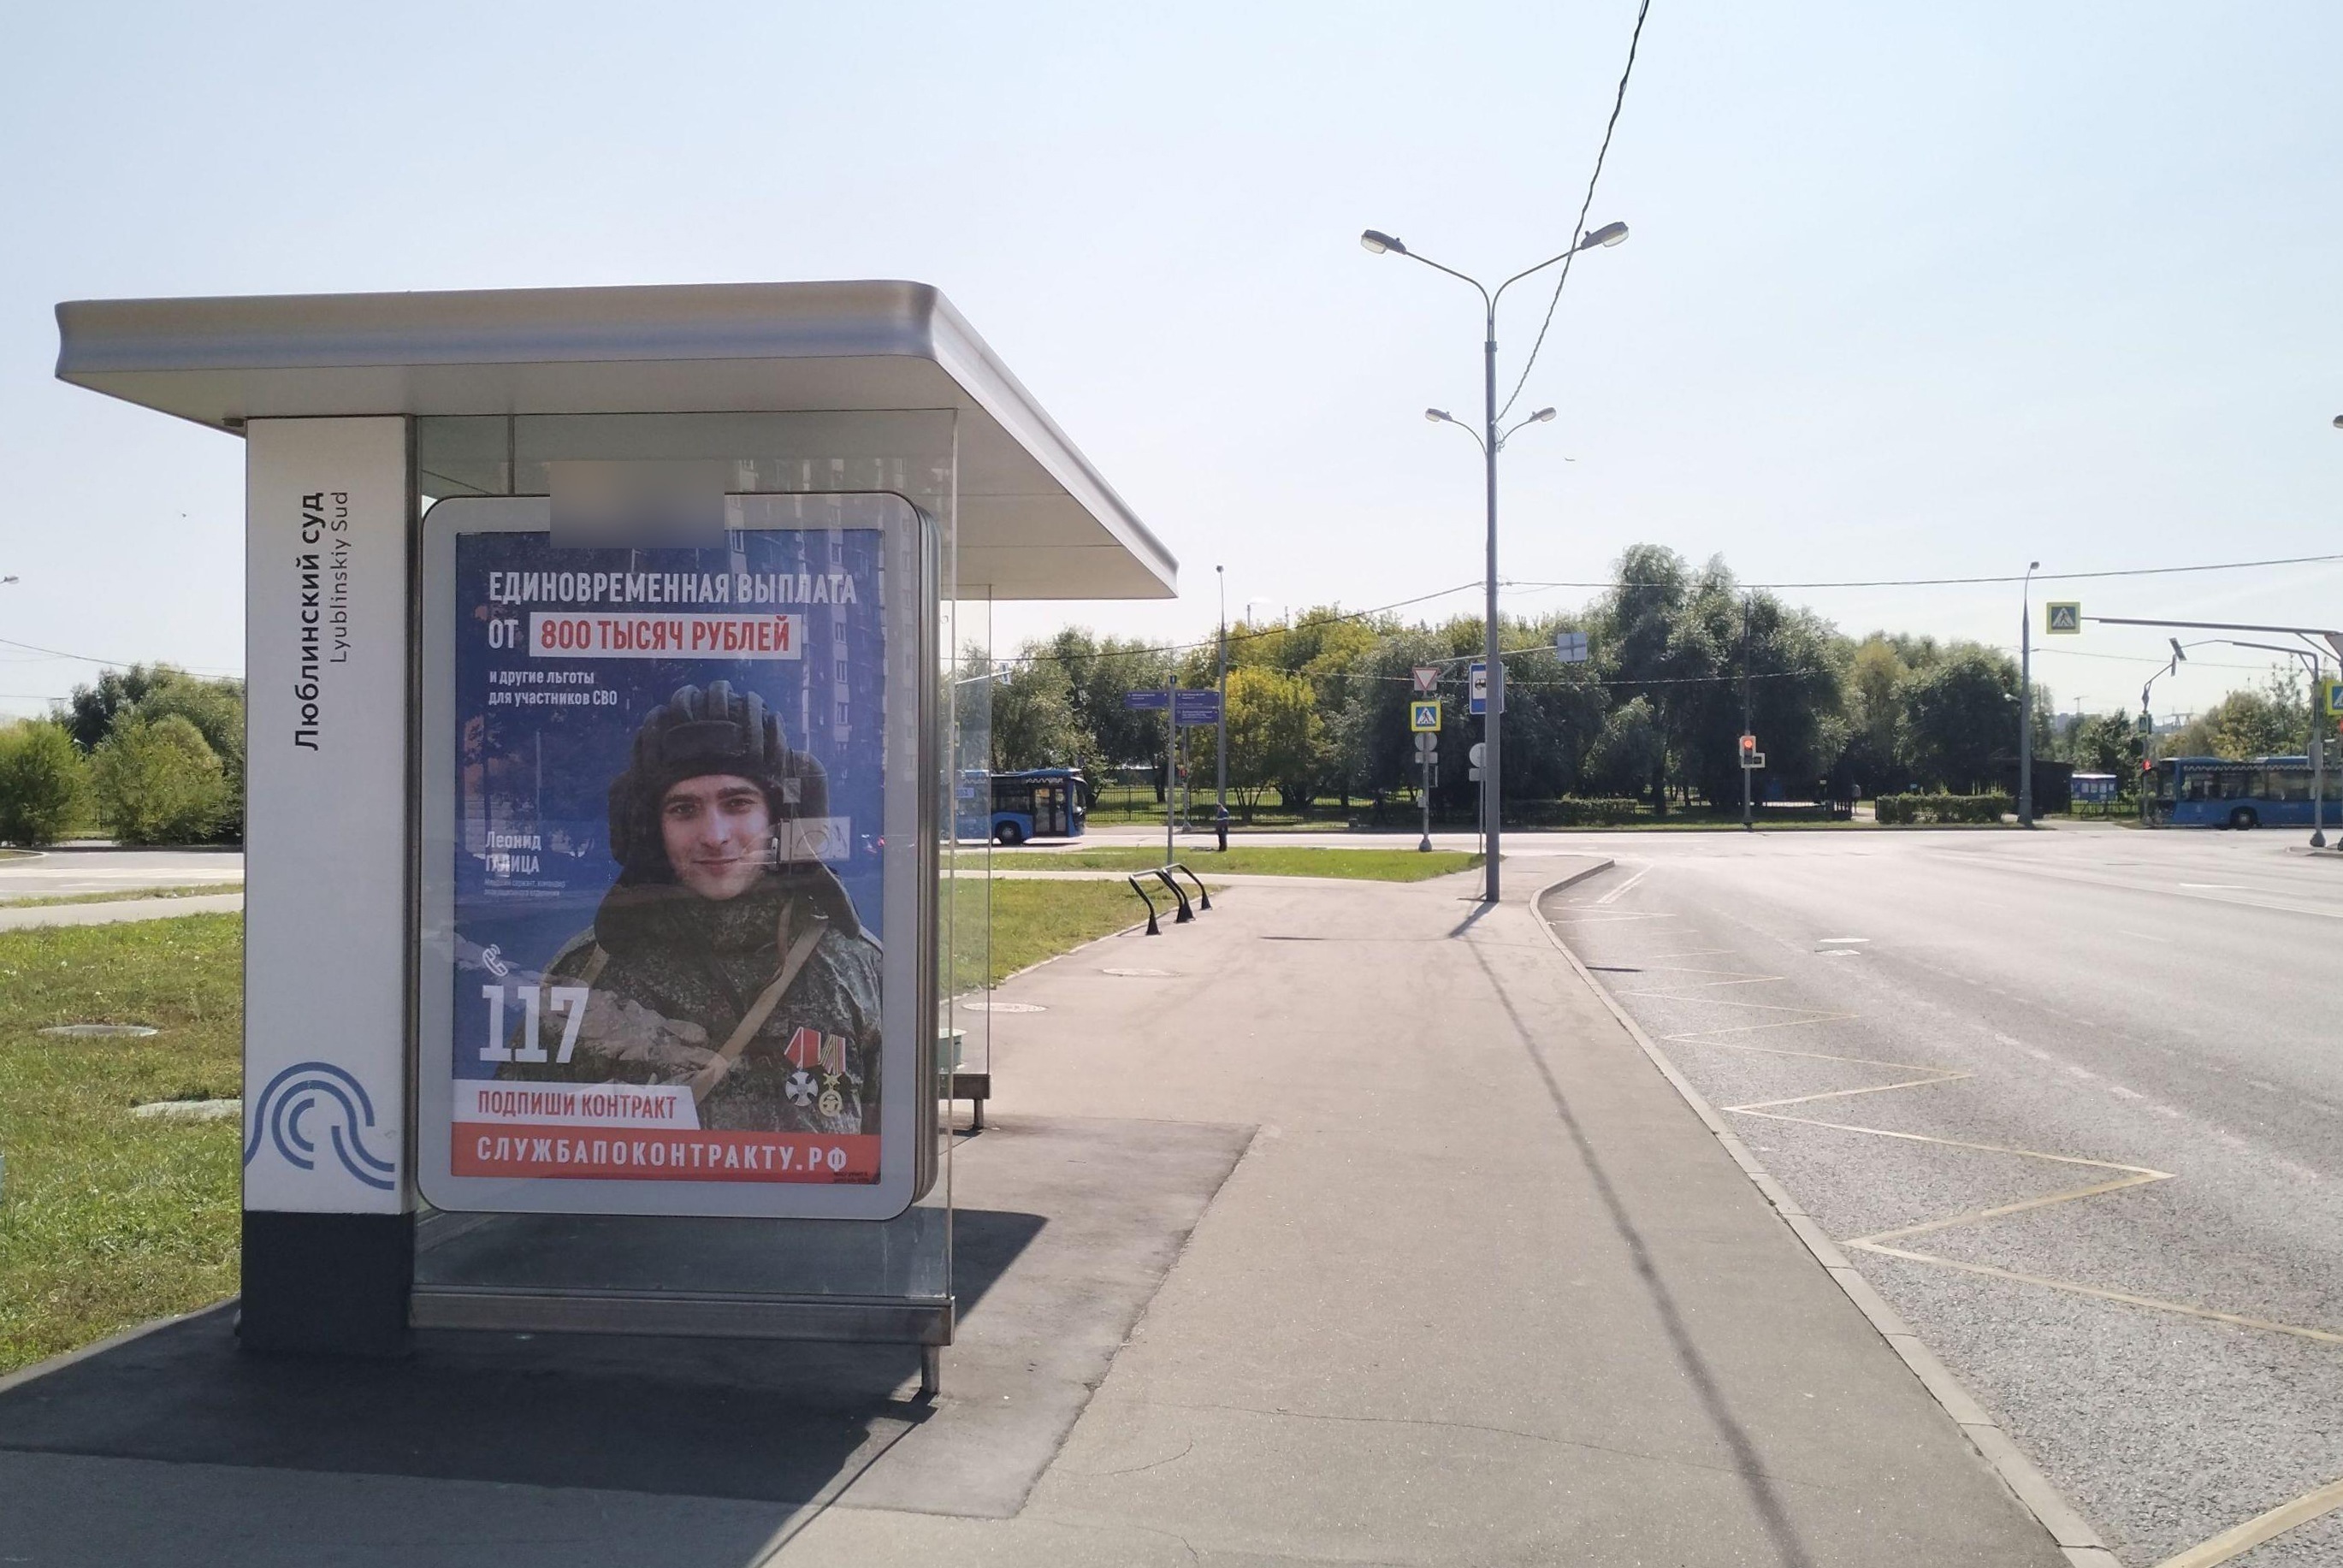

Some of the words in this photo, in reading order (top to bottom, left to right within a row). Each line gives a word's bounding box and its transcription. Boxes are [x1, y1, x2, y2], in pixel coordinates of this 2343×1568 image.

[302, 492, 326, 544] суд
[329, 492, 348, 532] Sud
[329, 538, 352, 663] Lyublinskiy
[489, 571, 730, 605] ЕДИНОВРЕМЕННАЯ
[737, 573, 857, 604] ВЫПЛАТА
[488, 618, 519, 649] ОТ
[541, 619, 592, 649] 800
[597, 620, 683, 651] ТЫСЯЧ
[691, 615, 790, 652] РУБЛЕЙ
[294, 553, 320, 752] Люблинский
[489, 671, 497, 683] и
[499, 671, 544, 687] другие
[547, 671, 595, 684] льготы
[488, 691, 512, 706] для
[514, 690, 590, 707] участников
[592, 689, 618, 706] СВО
[485, 831, 542, 851] Леонид
[479, 985, 590, 1064] 117
[477, 1090, 576, 1117] ПОДПИШИ
[581, 1094, 677, 1120] КОНТРАКТ
[476, 1135, 848, 1173] СЛУЖБАПОКОНТРАКТУ.РФ
